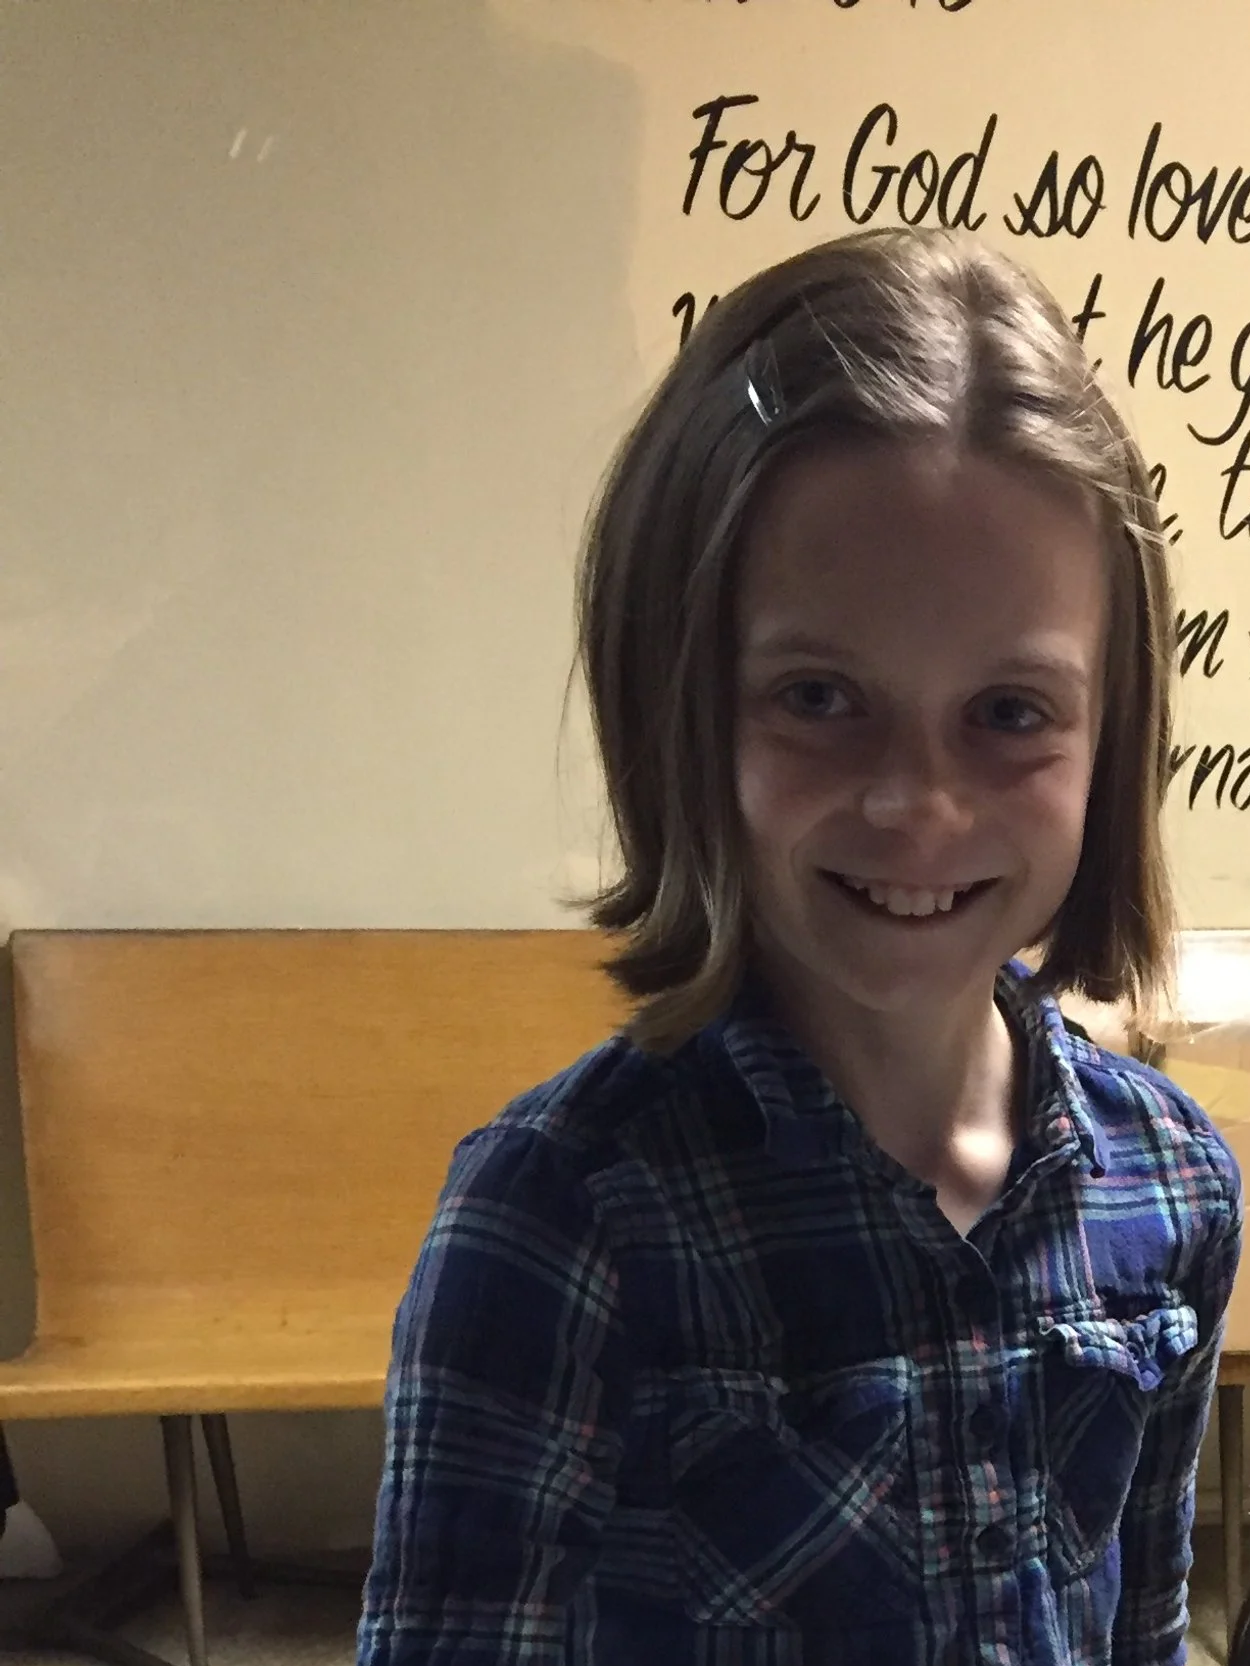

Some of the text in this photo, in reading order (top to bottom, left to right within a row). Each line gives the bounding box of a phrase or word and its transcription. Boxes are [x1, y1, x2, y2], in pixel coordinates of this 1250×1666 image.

[682, 94, 821, 222] For
[842, 102, 998, 232] God
[1003, 150, 1106, 239] so
[1127, 277, 1212, 394] he
